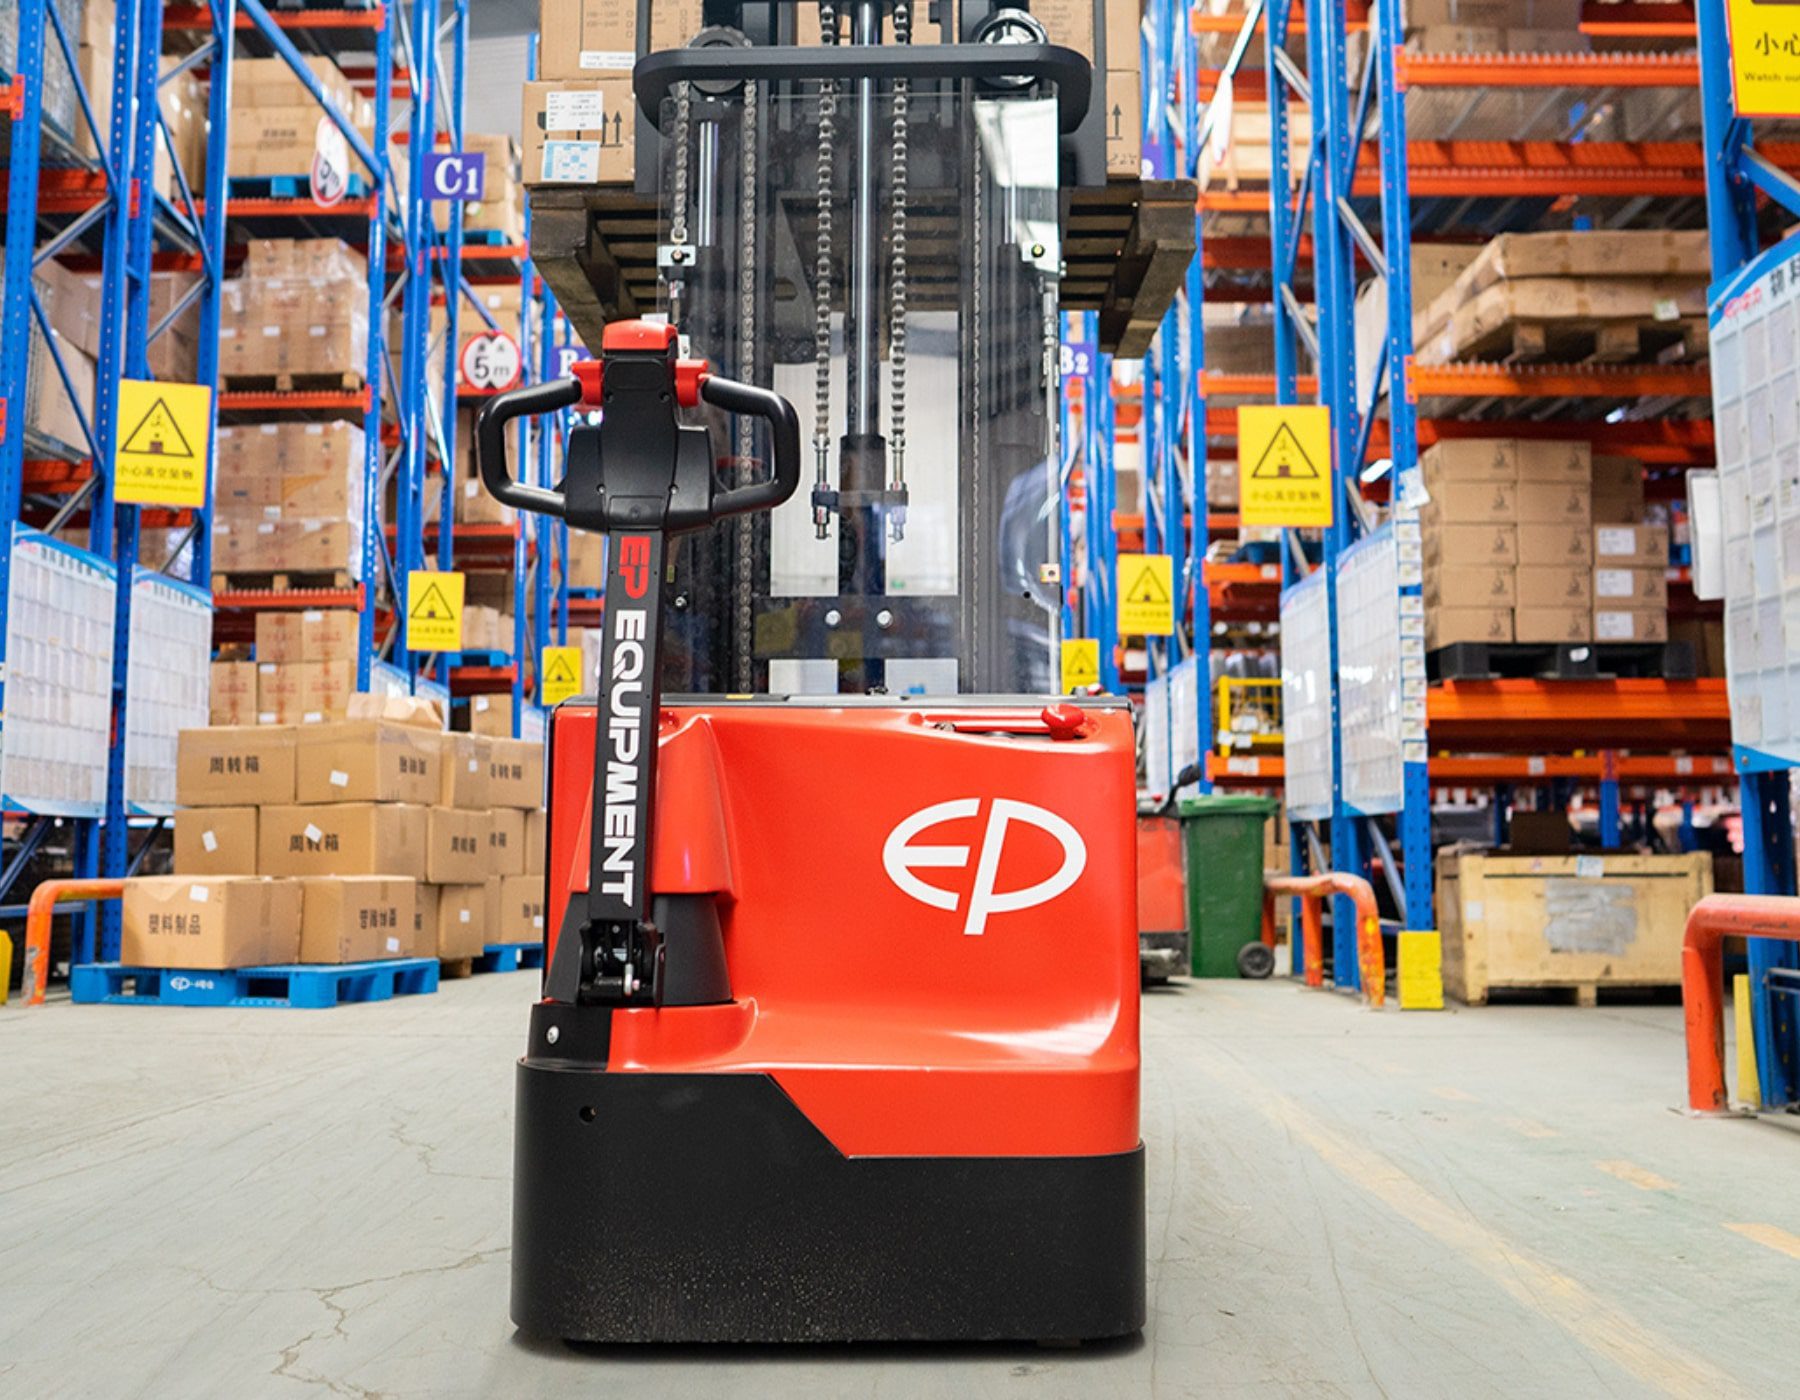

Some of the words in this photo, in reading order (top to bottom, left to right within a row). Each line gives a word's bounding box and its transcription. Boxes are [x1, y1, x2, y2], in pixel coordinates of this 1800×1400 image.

[434, 157, 478, 195] C1
[1060, 345, 1089, 375] B2
[619, 536, 651, 599] EP
[602, 609, 647, 908] EQUIPMENT
[883, 797, 1088, 936] EP
